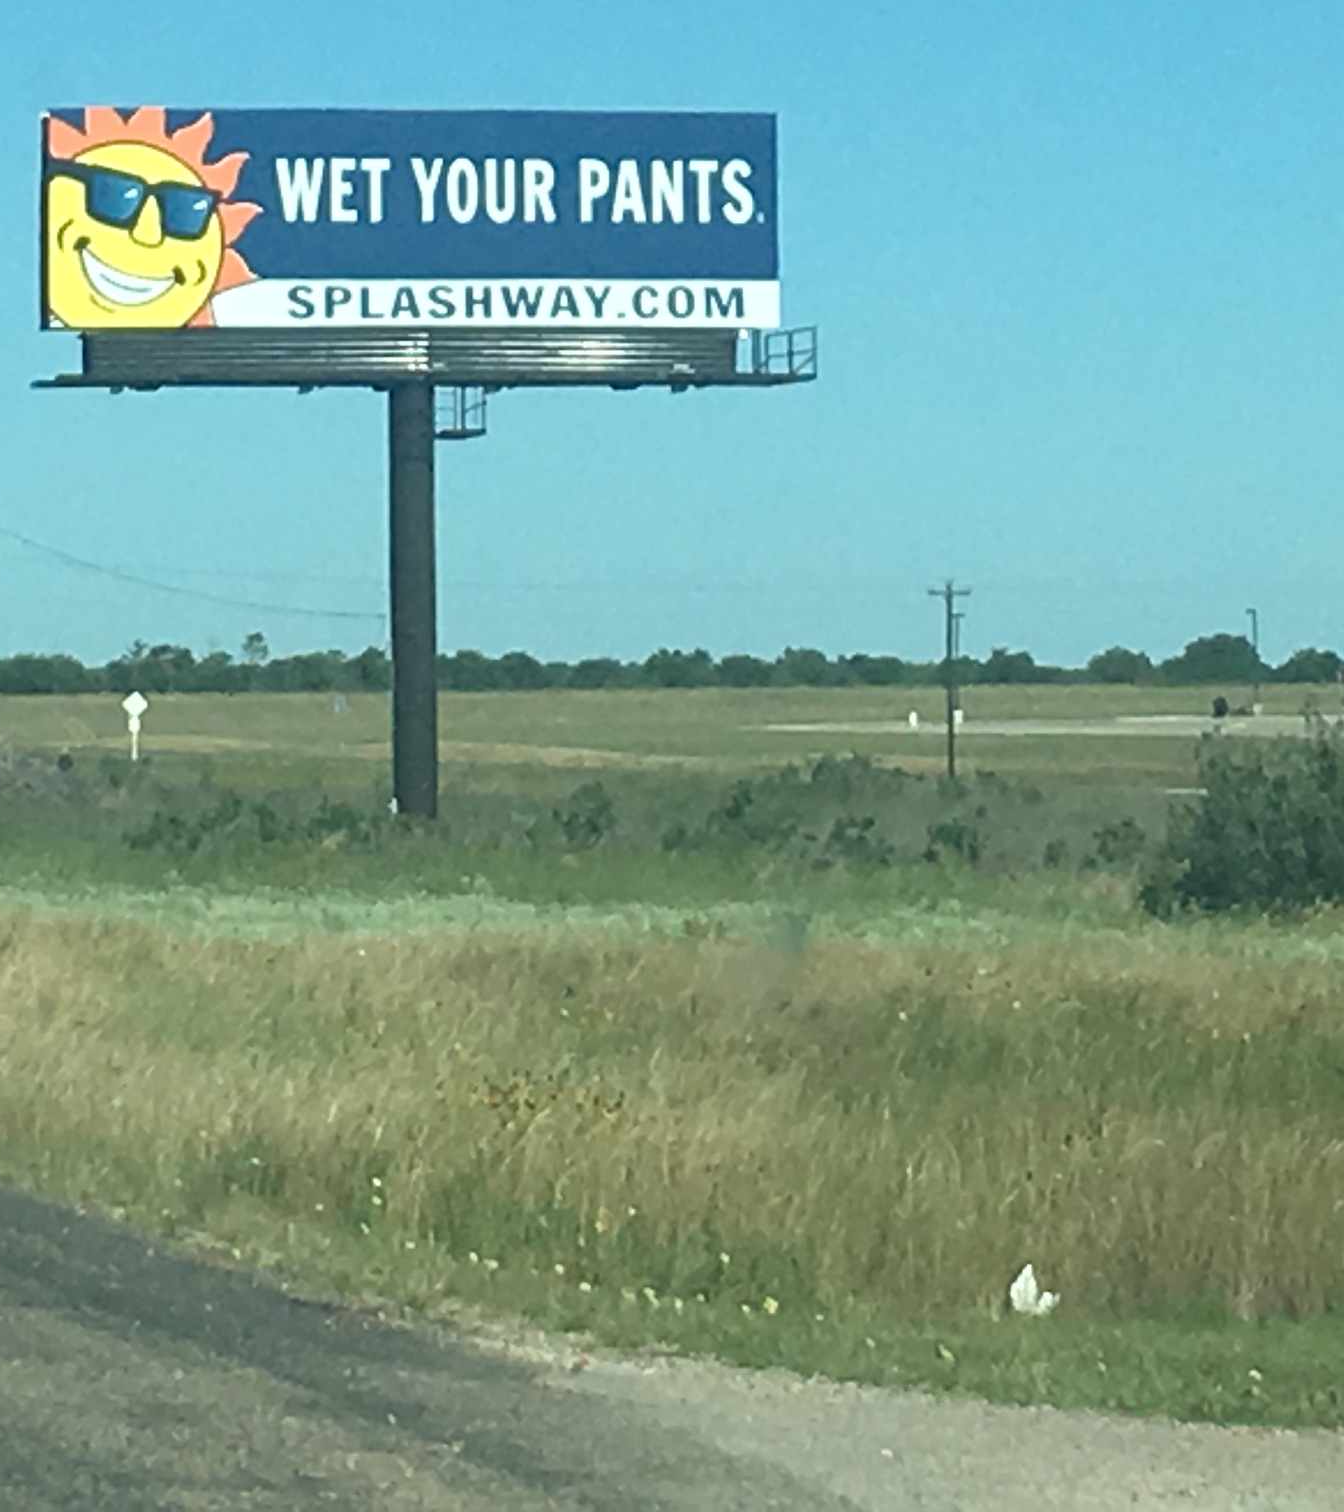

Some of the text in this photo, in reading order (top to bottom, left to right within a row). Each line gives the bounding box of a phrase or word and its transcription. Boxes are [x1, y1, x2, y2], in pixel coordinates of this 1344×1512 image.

[275, 157, 391, 224] WET
[410, 157, 557, 224] YOUR
[287, 285, 747, 319] SPLASHWAY.COM
